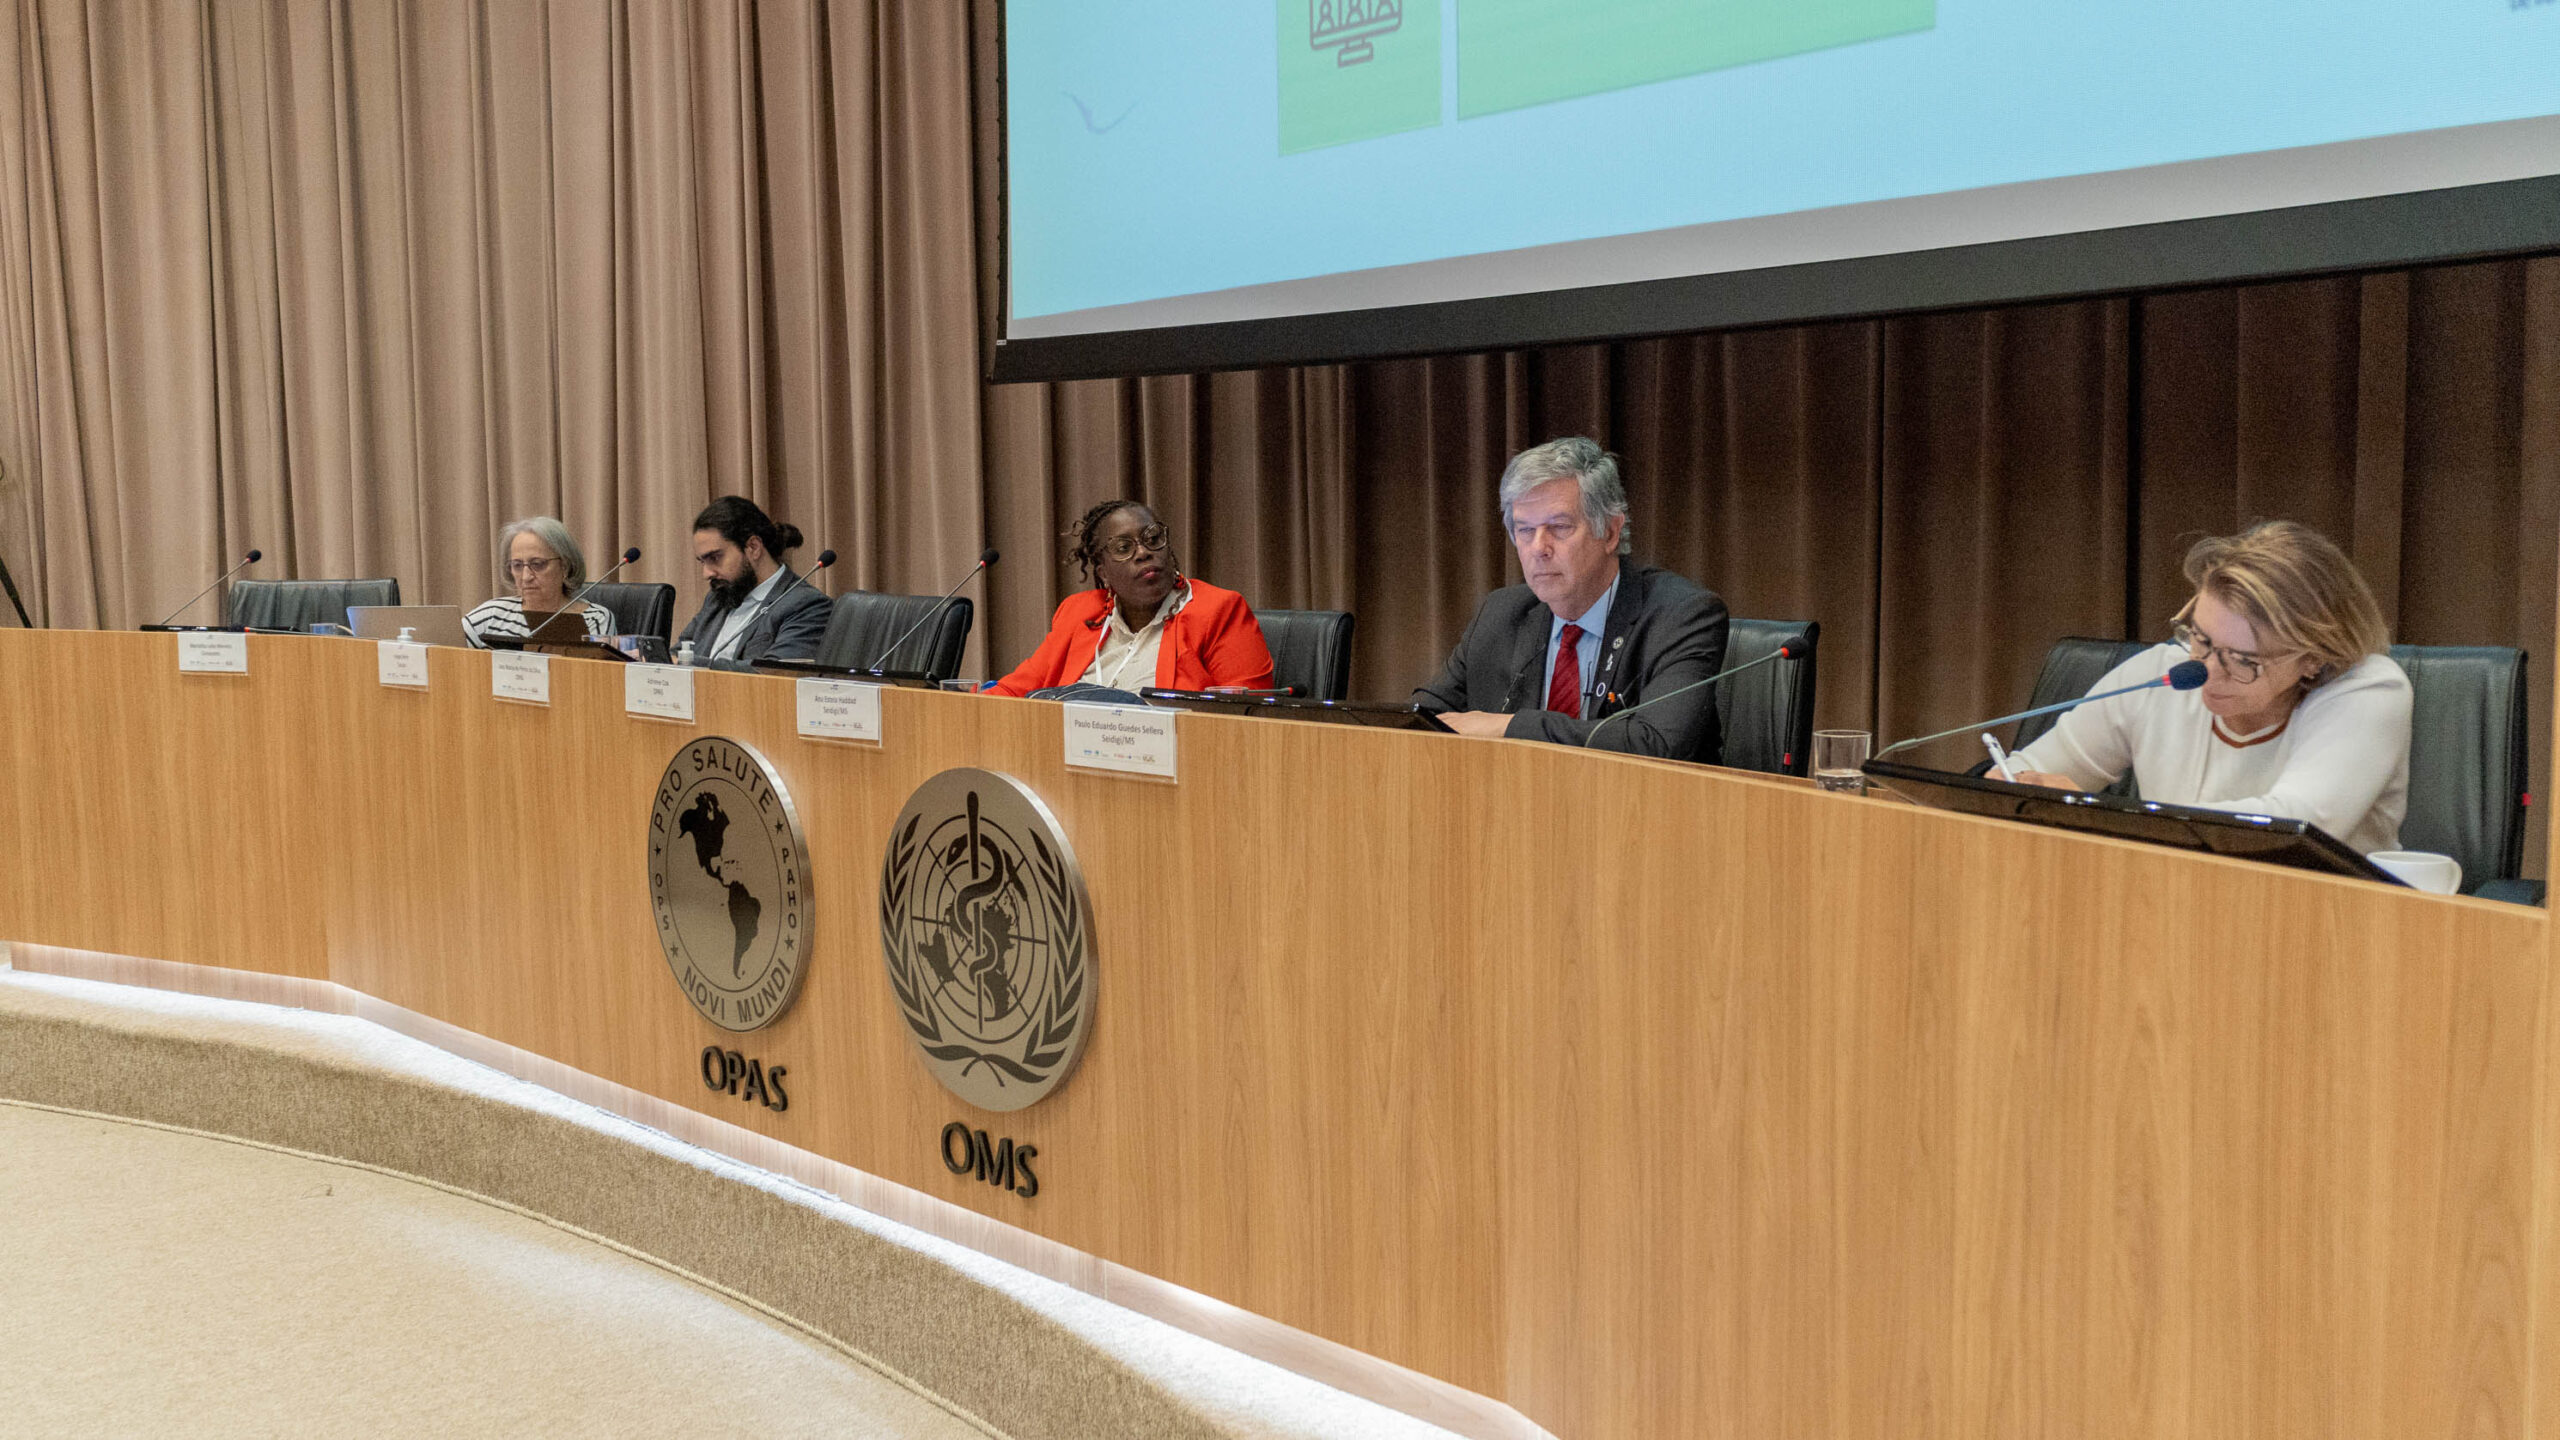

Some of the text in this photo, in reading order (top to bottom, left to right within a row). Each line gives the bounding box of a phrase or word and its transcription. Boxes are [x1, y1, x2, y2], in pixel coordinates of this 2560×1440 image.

[1074, 720, 1091, 729] Paulo
[1092, 720, 1117, 732] Eduardo
[1118, 723, 1141, 733] Guedes
[654, 746, 774, 833] PRO SALUTE
[654, 873, 670, 930] OPS
[782, 848, 797, 929] PAHO
[683, 958, 791, 1023] NOVI MUNDI
[700, 1045, 788, 1112] OPAS
[941, 1121, 1039, 1198] OMS
